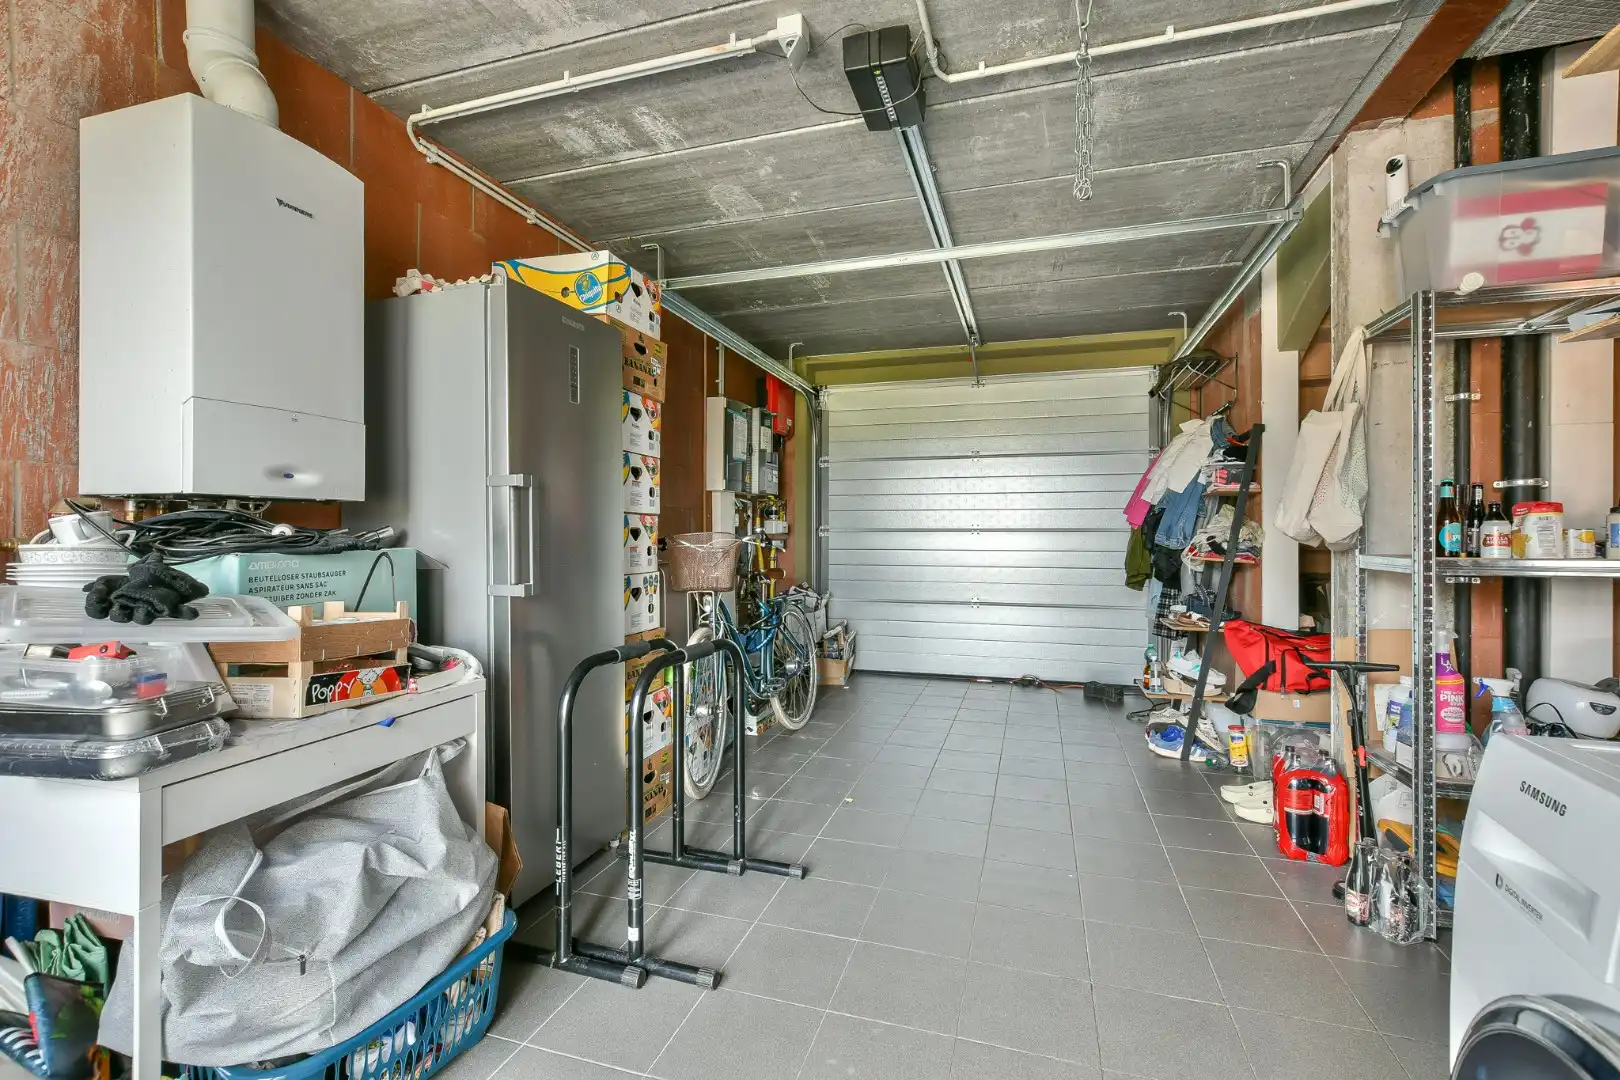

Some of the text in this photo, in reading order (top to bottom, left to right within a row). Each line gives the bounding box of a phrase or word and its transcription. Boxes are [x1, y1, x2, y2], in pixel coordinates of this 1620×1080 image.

[248, 570, 347, 583] BEUTELLOSER STAUBSAUGER
[248, 584, 294, 594] ASPIRATEUR
[296, 582, 314, 590] SANS
[296, 591, 323, 600] ZONDER
[1440, 693, 1464, 702] PINK
[1519, 780, 1567, 817] SAMSUNG
